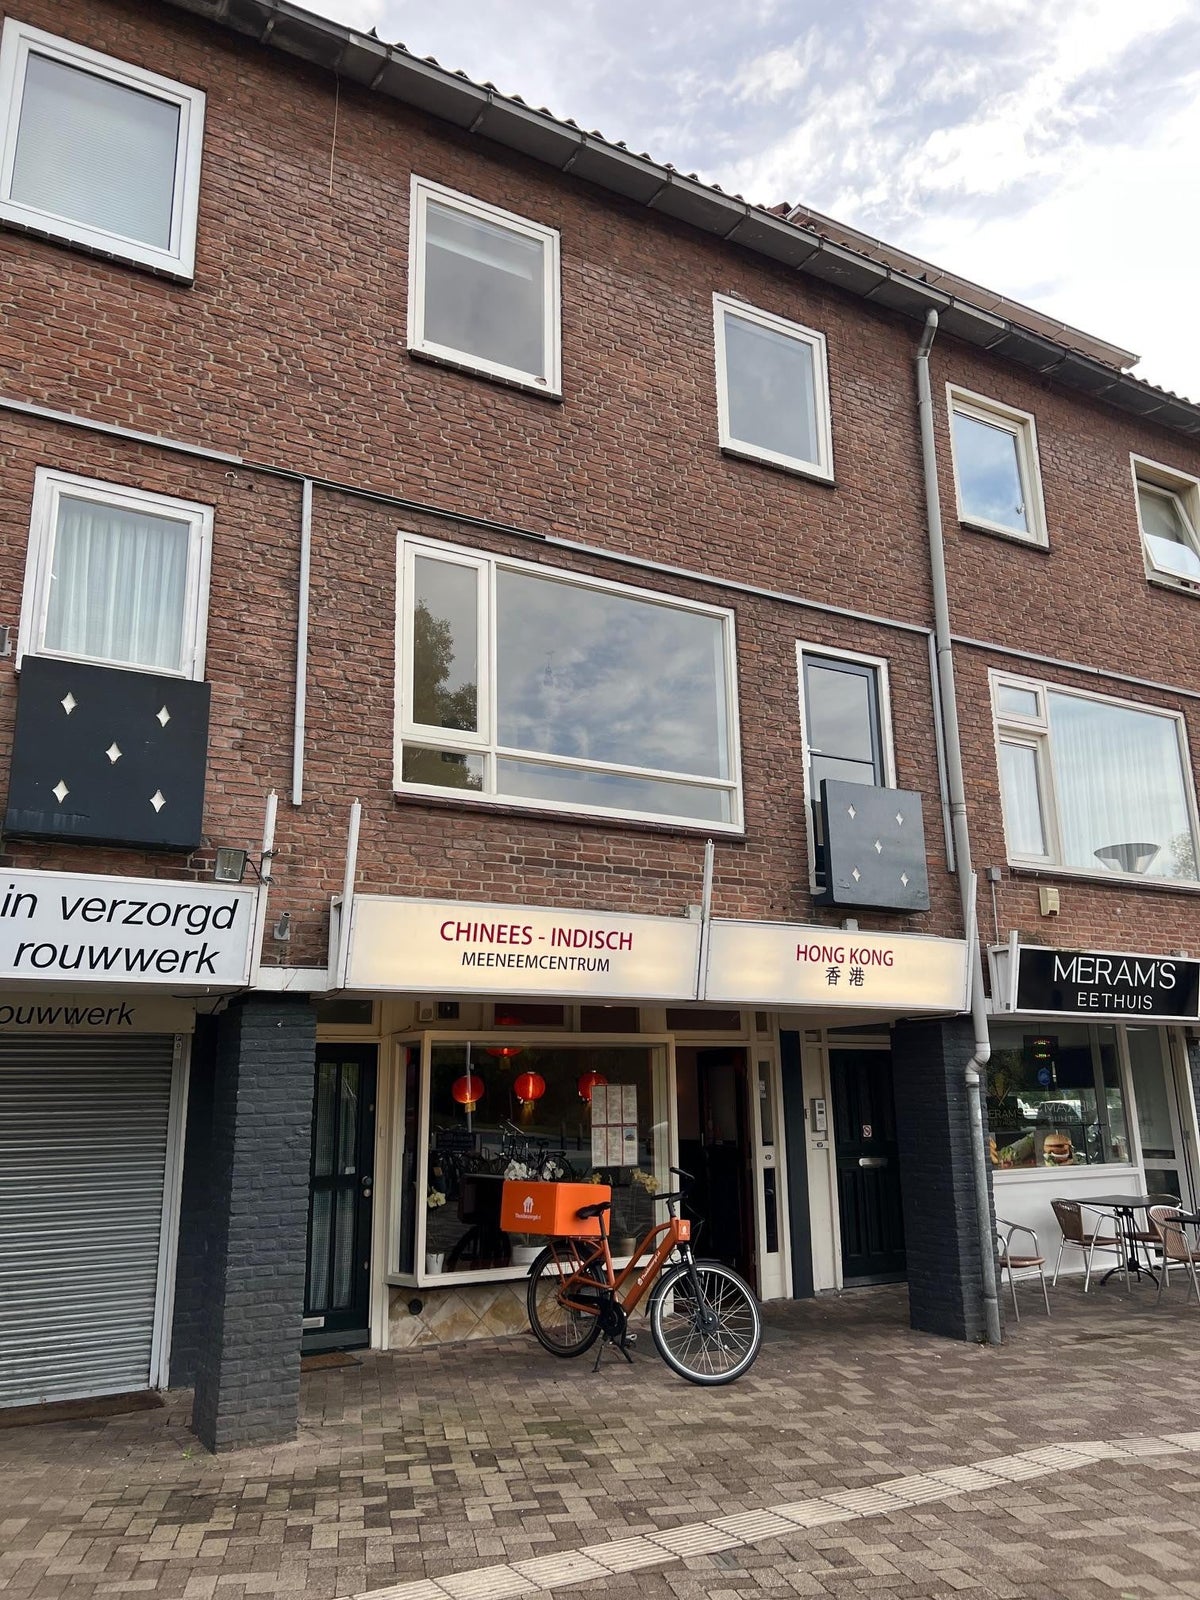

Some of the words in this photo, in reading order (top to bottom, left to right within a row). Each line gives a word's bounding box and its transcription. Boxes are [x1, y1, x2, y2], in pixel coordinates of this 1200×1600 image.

[0, 884, 38, 919] in
[61, 895, 240, 936] verzorgd
[440, 920, 533, 946] CHINEES
[551, 927, 633, 951] INDISCH
[13, 942, 221, 975] rouwwerk
[461, 951, 610, 973] MEENEEMCENTRUM
[797, 943, 845, 964] HONG
[849, 947, 894, 967] KONG
[825, 965, 865, 987] 香港
[1053, 954, 1176, 990] MERAM'S
[1077, 991, 1153, 1010] EETHUIS
